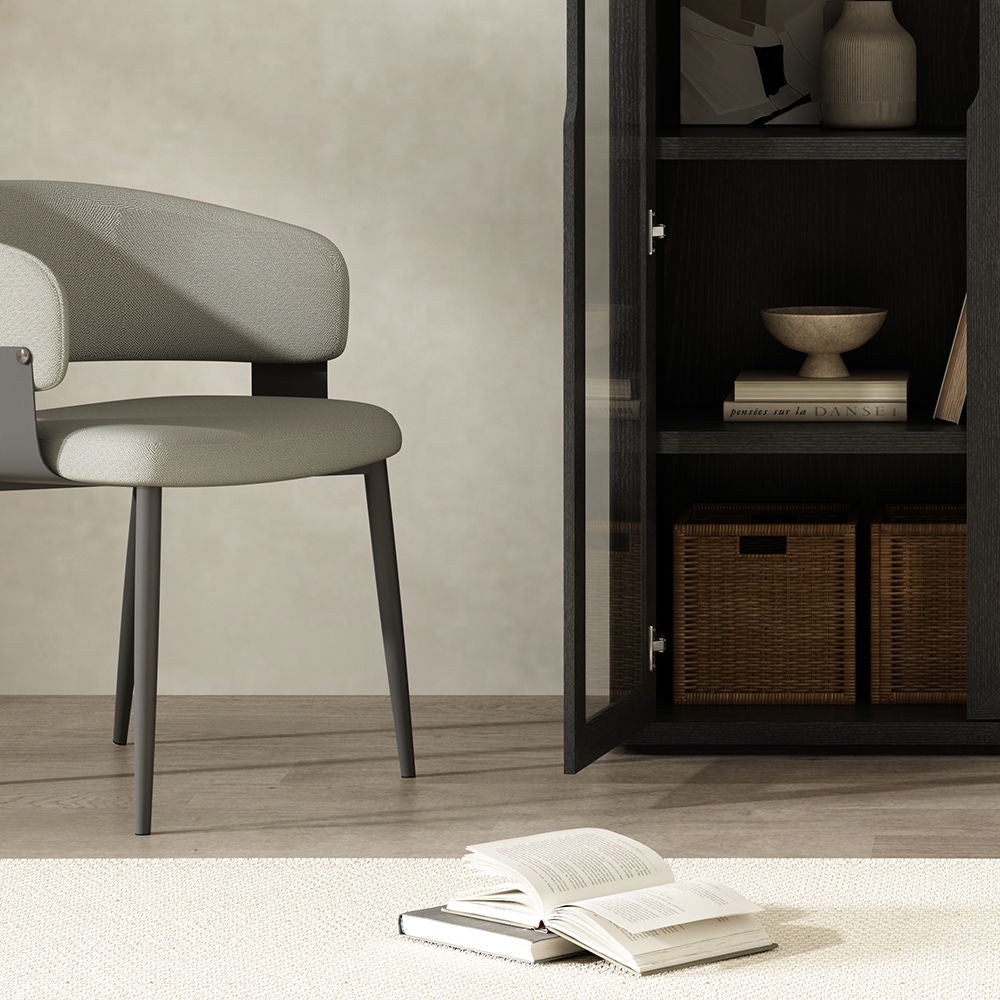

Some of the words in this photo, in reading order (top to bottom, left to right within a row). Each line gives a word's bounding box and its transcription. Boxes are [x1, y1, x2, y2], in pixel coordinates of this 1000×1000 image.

[729, 407, 769, 417] pensées
[772, 408, 790, 416] sur
[795, 407, 808, 416] la
[814, 406, 885, 416] DANSE
